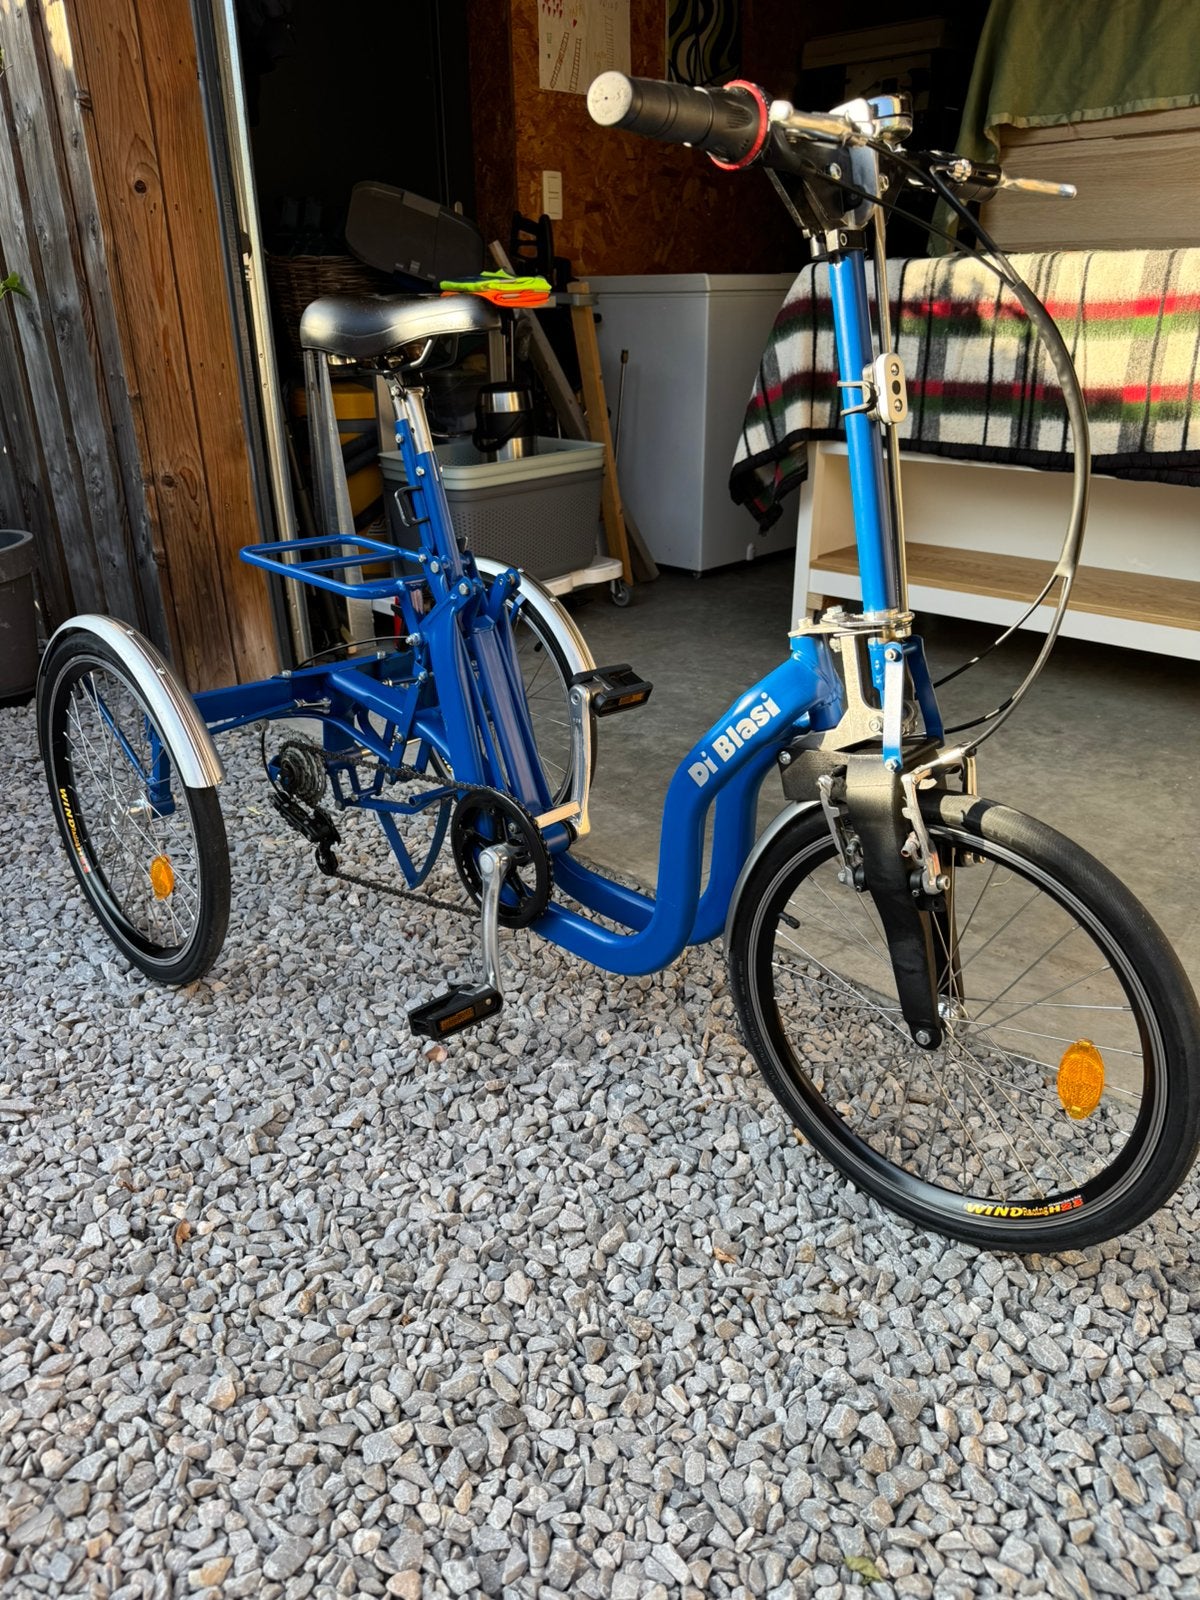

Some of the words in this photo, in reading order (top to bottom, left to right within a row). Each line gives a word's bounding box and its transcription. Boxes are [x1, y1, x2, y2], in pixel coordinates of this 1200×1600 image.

[687, 750, 719, 788] Di
[711, 691, 781, 763] Blasi
[59, 788, 75, 829] WIND
[966, 1202, 1023, 1217] WIND
